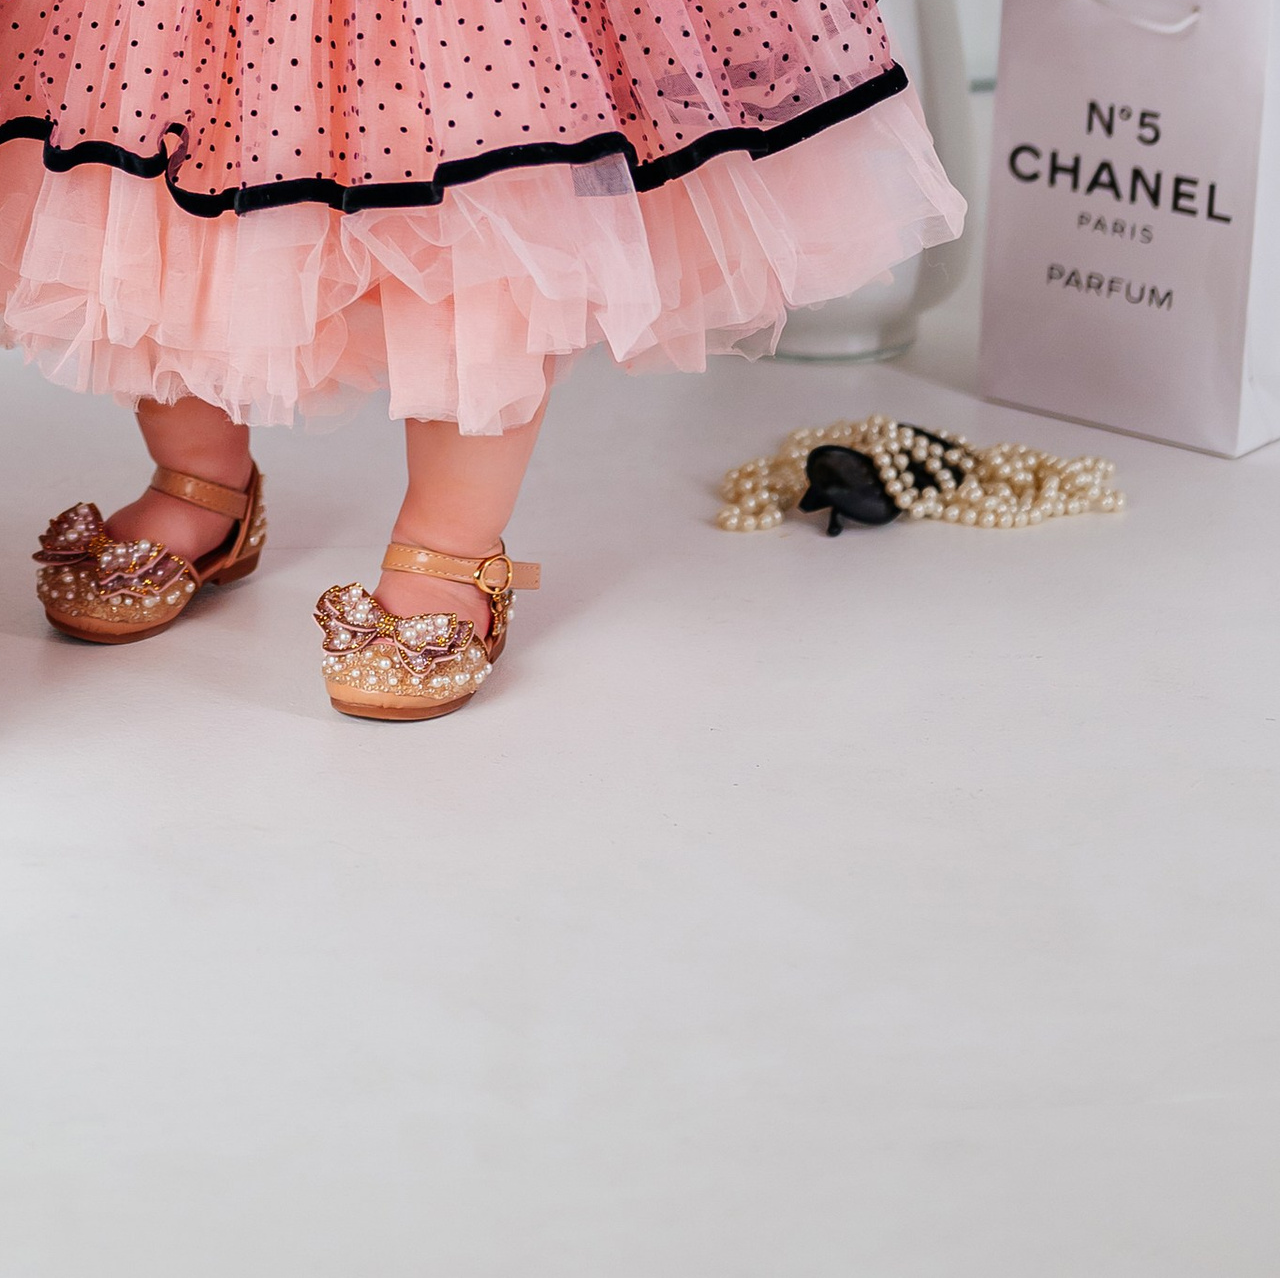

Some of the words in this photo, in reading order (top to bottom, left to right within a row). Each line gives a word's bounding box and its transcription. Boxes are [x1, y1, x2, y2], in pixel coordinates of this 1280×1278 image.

[1008, 143, 1234, 225] CHANEL
[1076, 210, 1155, 245] PARIS
[1045, 262, 1175, 311] PARFUM
